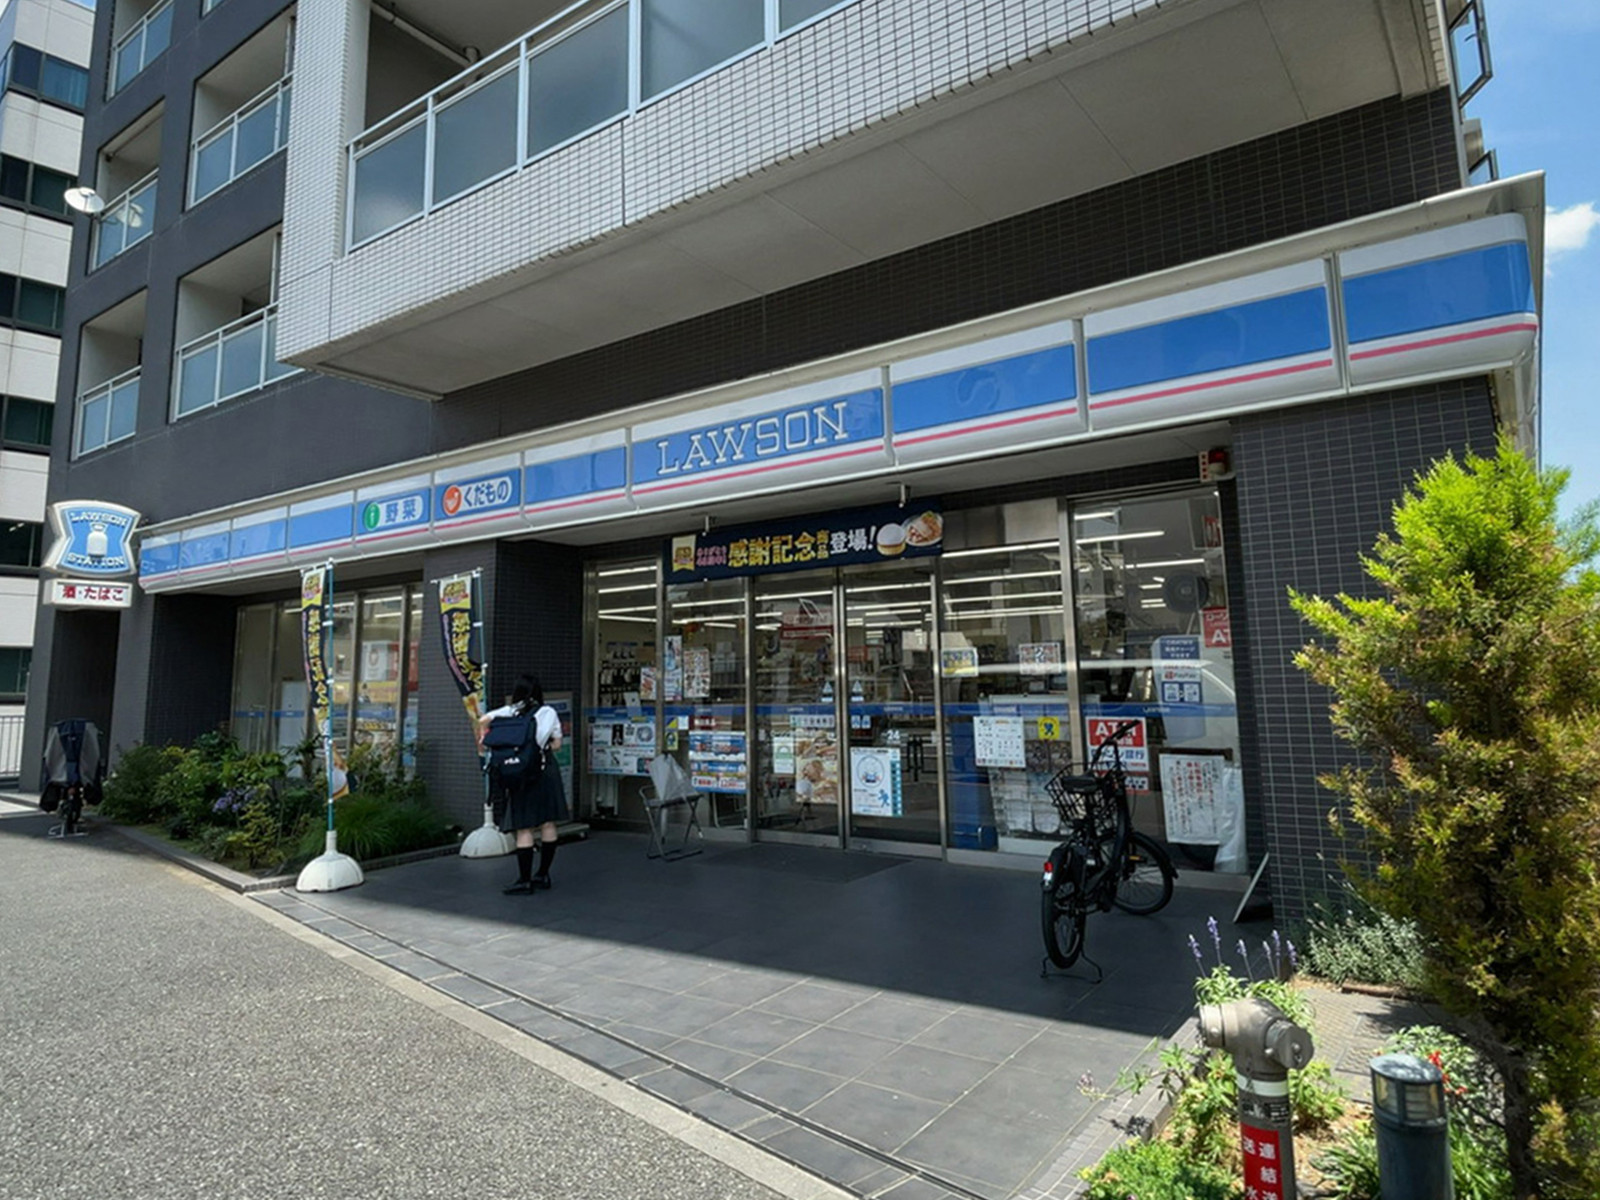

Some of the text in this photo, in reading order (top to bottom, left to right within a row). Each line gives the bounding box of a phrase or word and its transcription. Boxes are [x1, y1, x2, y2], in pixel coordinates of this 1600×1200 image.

[658, 402, 848, 474] LAWSON
[463, 480, 509, 507] くだもの
[70, 511, 129, 527] LAWSON
[385, 498, 417, 523] 野菜
[67, 553, 126, 567] STATION
